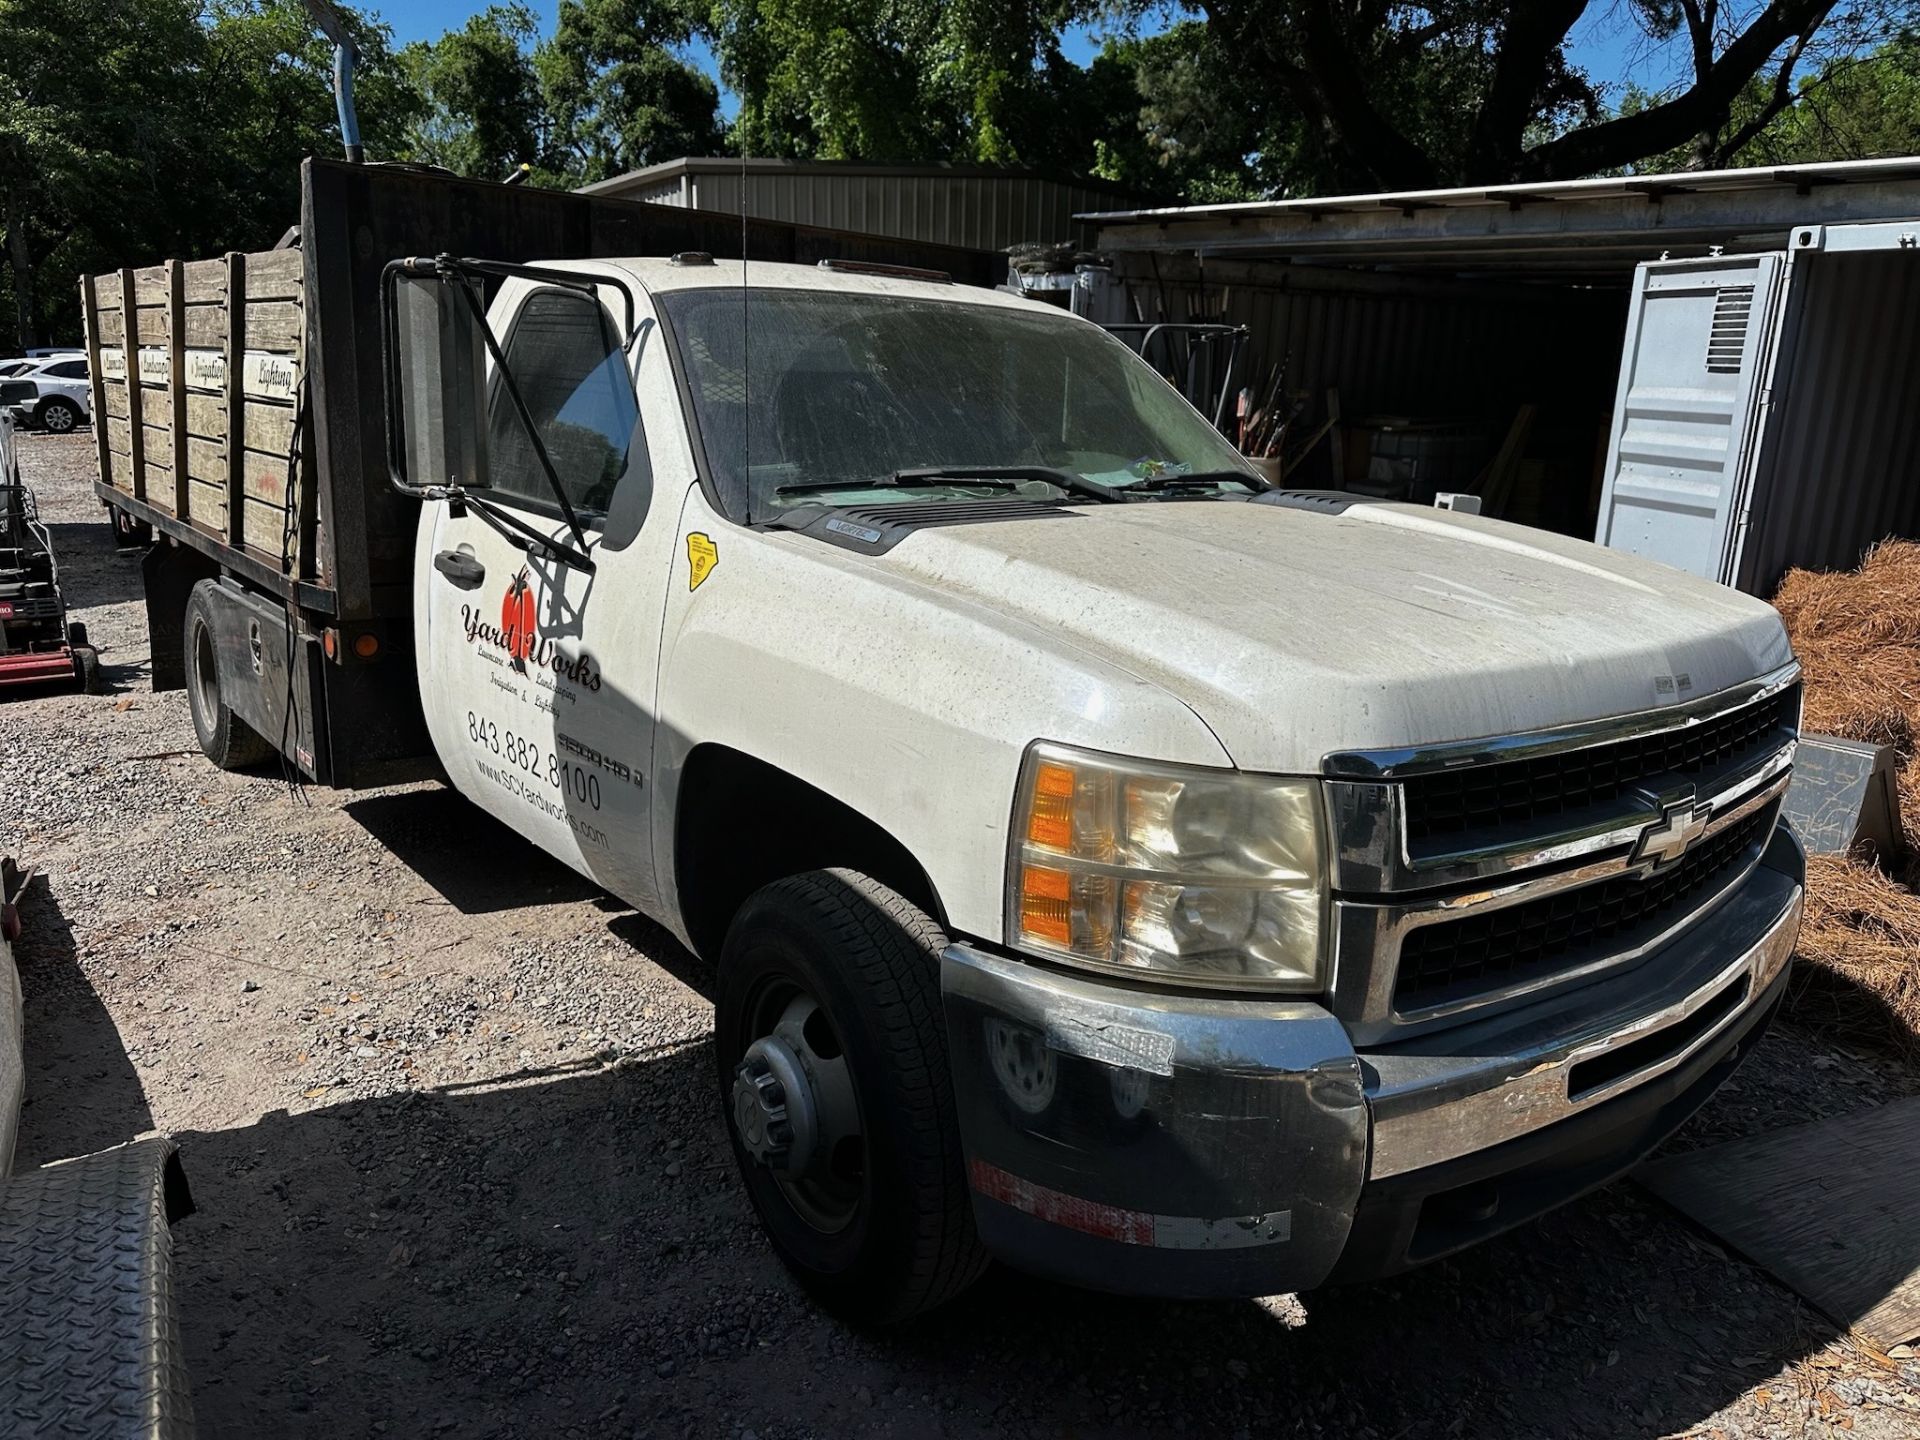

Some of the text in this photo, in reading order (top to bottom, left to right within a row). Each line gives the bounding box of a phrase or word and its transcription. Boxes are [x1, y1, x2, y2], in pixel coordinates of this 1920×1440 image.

[258, 360, 292, 396] Lighting
[461, 603, 601, 691] Yard Works
[468, 710, 601, 811] 843.882.8100
